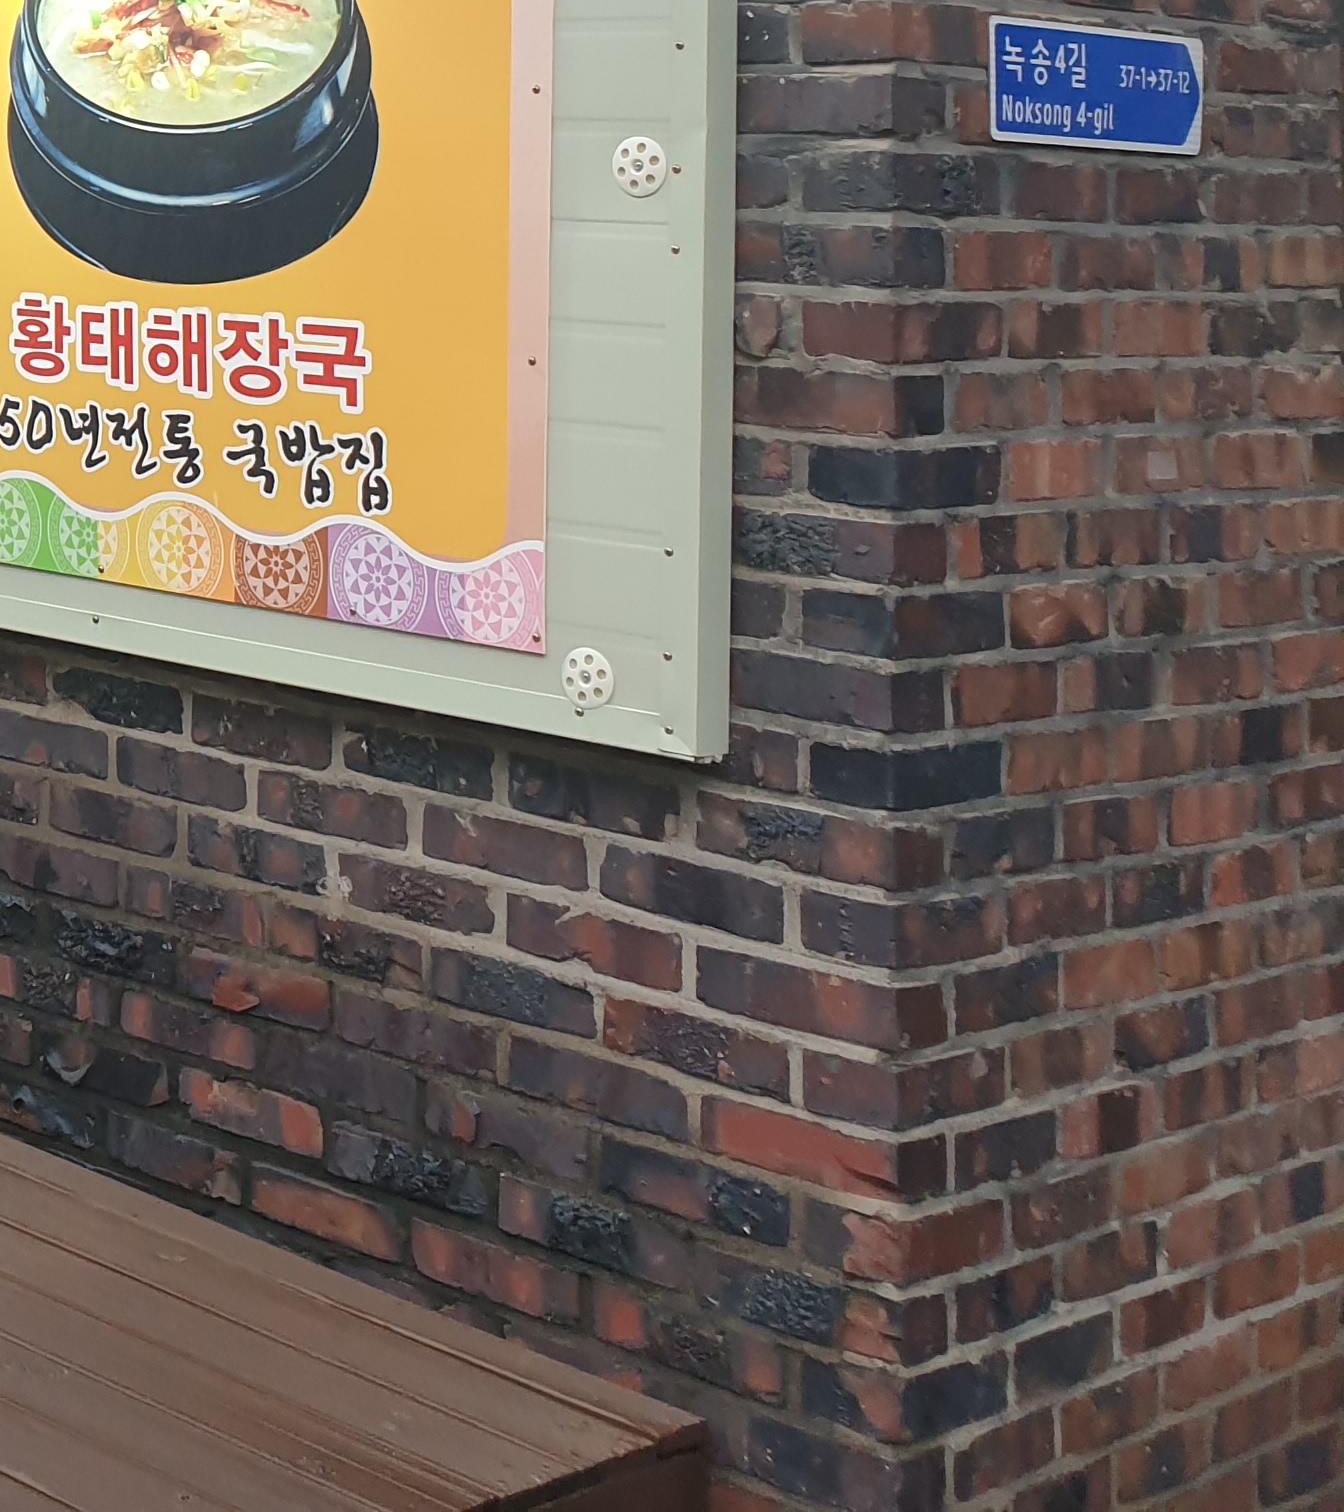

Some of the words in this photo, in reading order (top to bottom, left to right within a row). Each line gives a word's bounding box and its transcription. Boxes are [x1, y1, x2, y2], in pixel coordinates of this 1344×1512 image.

[1002, 35, 1087, 89] 녹송4길
[1002, 94, 1072, 133] Noksong
[1076, 101, 1115, 136] 4-gil
[11, 296, 368, 410] 황태해장국
[225, 422, 390, 514] 국밥집
